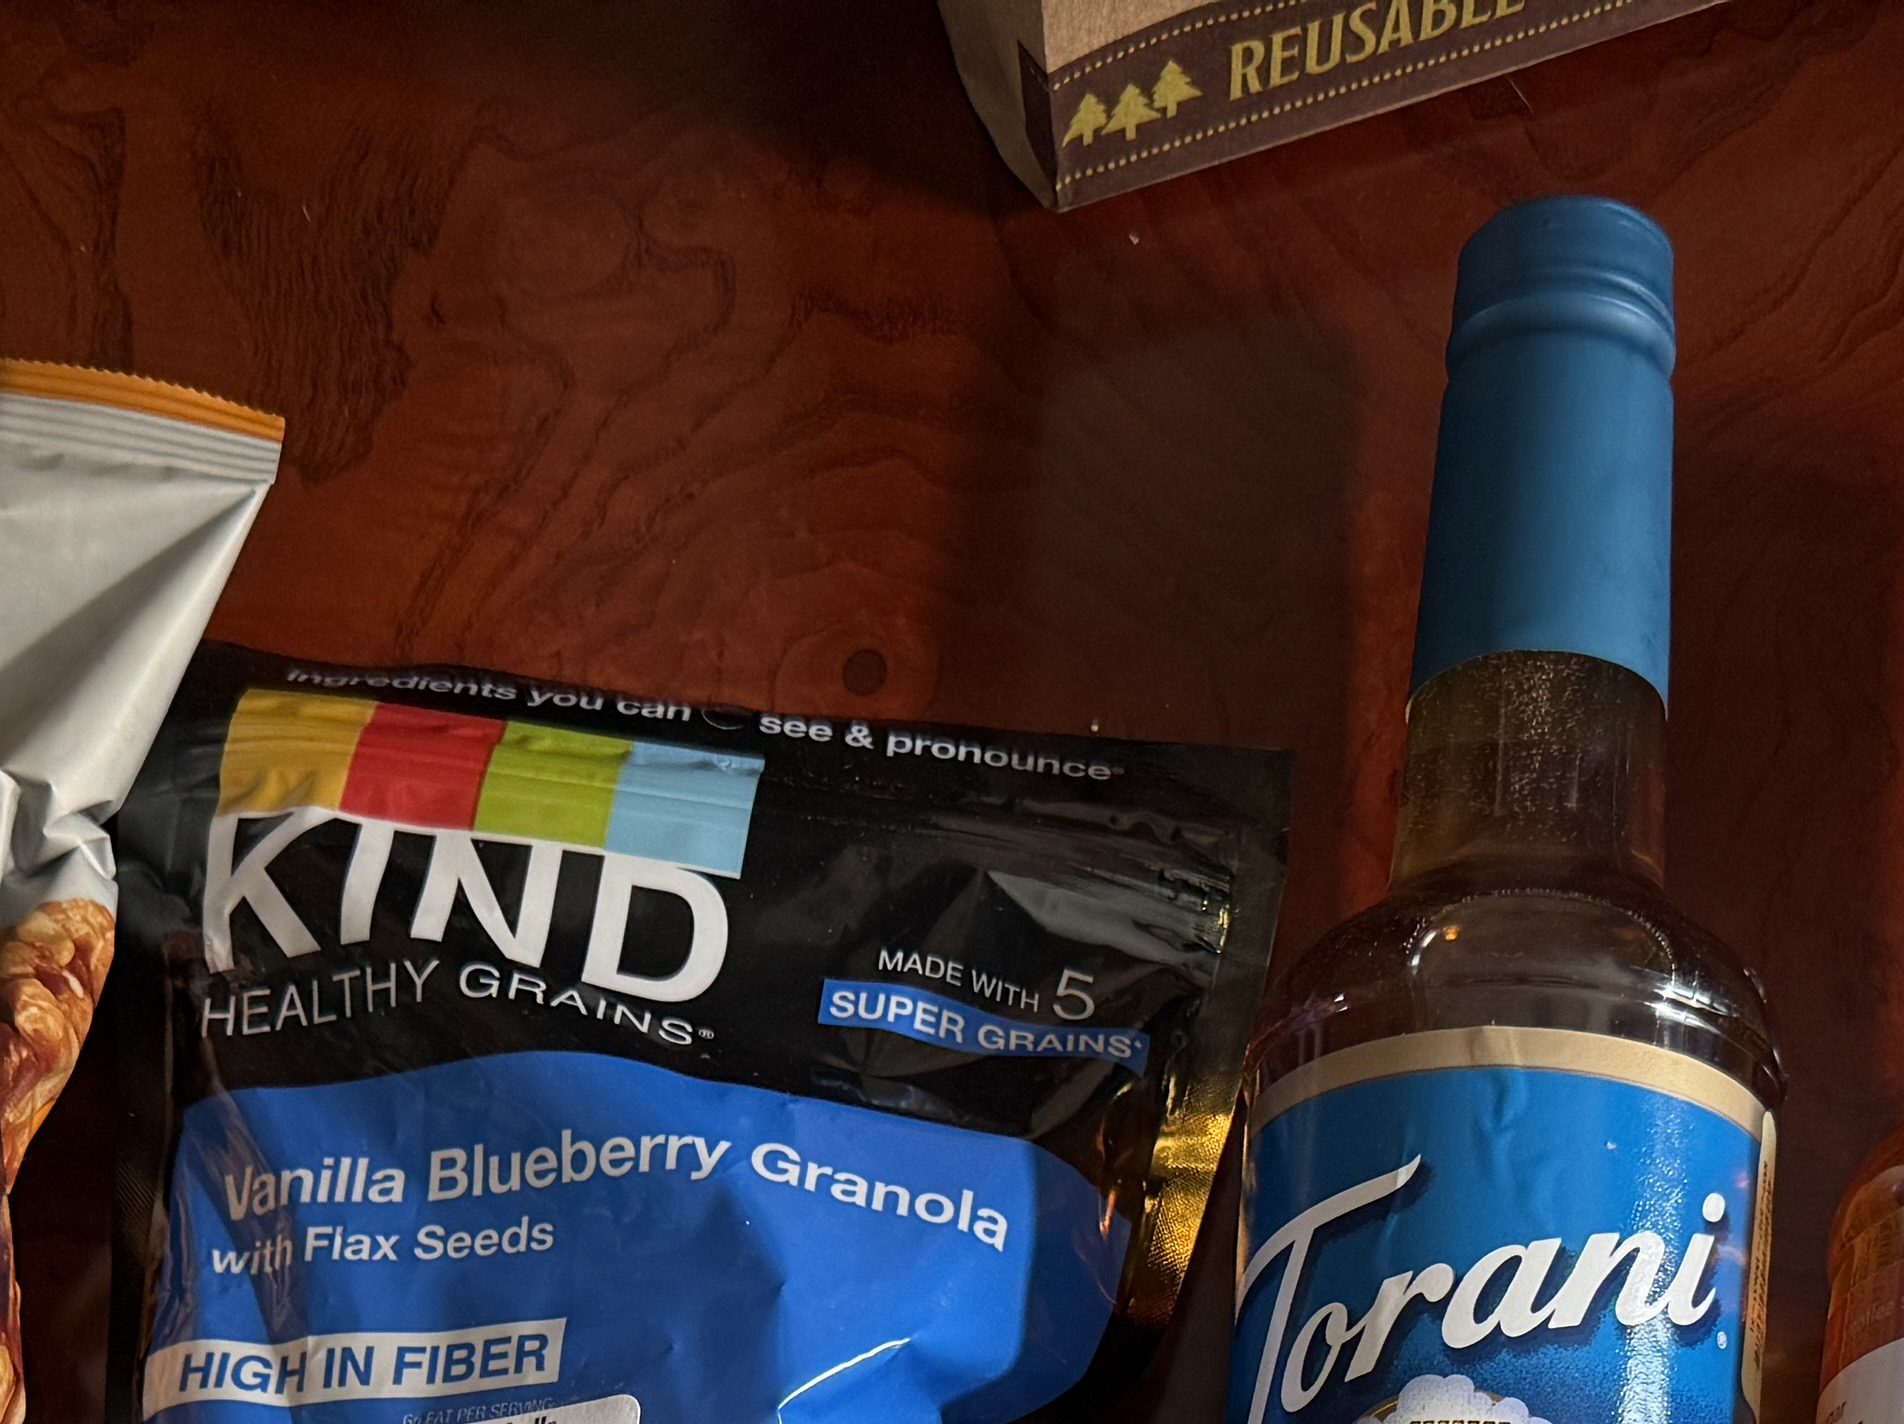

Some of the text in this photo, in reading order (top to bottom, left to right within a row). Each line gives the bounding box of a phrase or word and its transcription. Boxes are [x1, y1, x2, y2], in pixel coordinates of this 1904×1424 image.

[202, 810, 729, 1003] KIND
[878, 948, 1096, 1020] MADE WITH 5
[223, 1130, 1010, 1251] Vanilla Blueberry Granola
[212, 1217, 555, 1276] with Flax Seeds
[178, 1333, 551, 1393] HIGH IN FIBER
